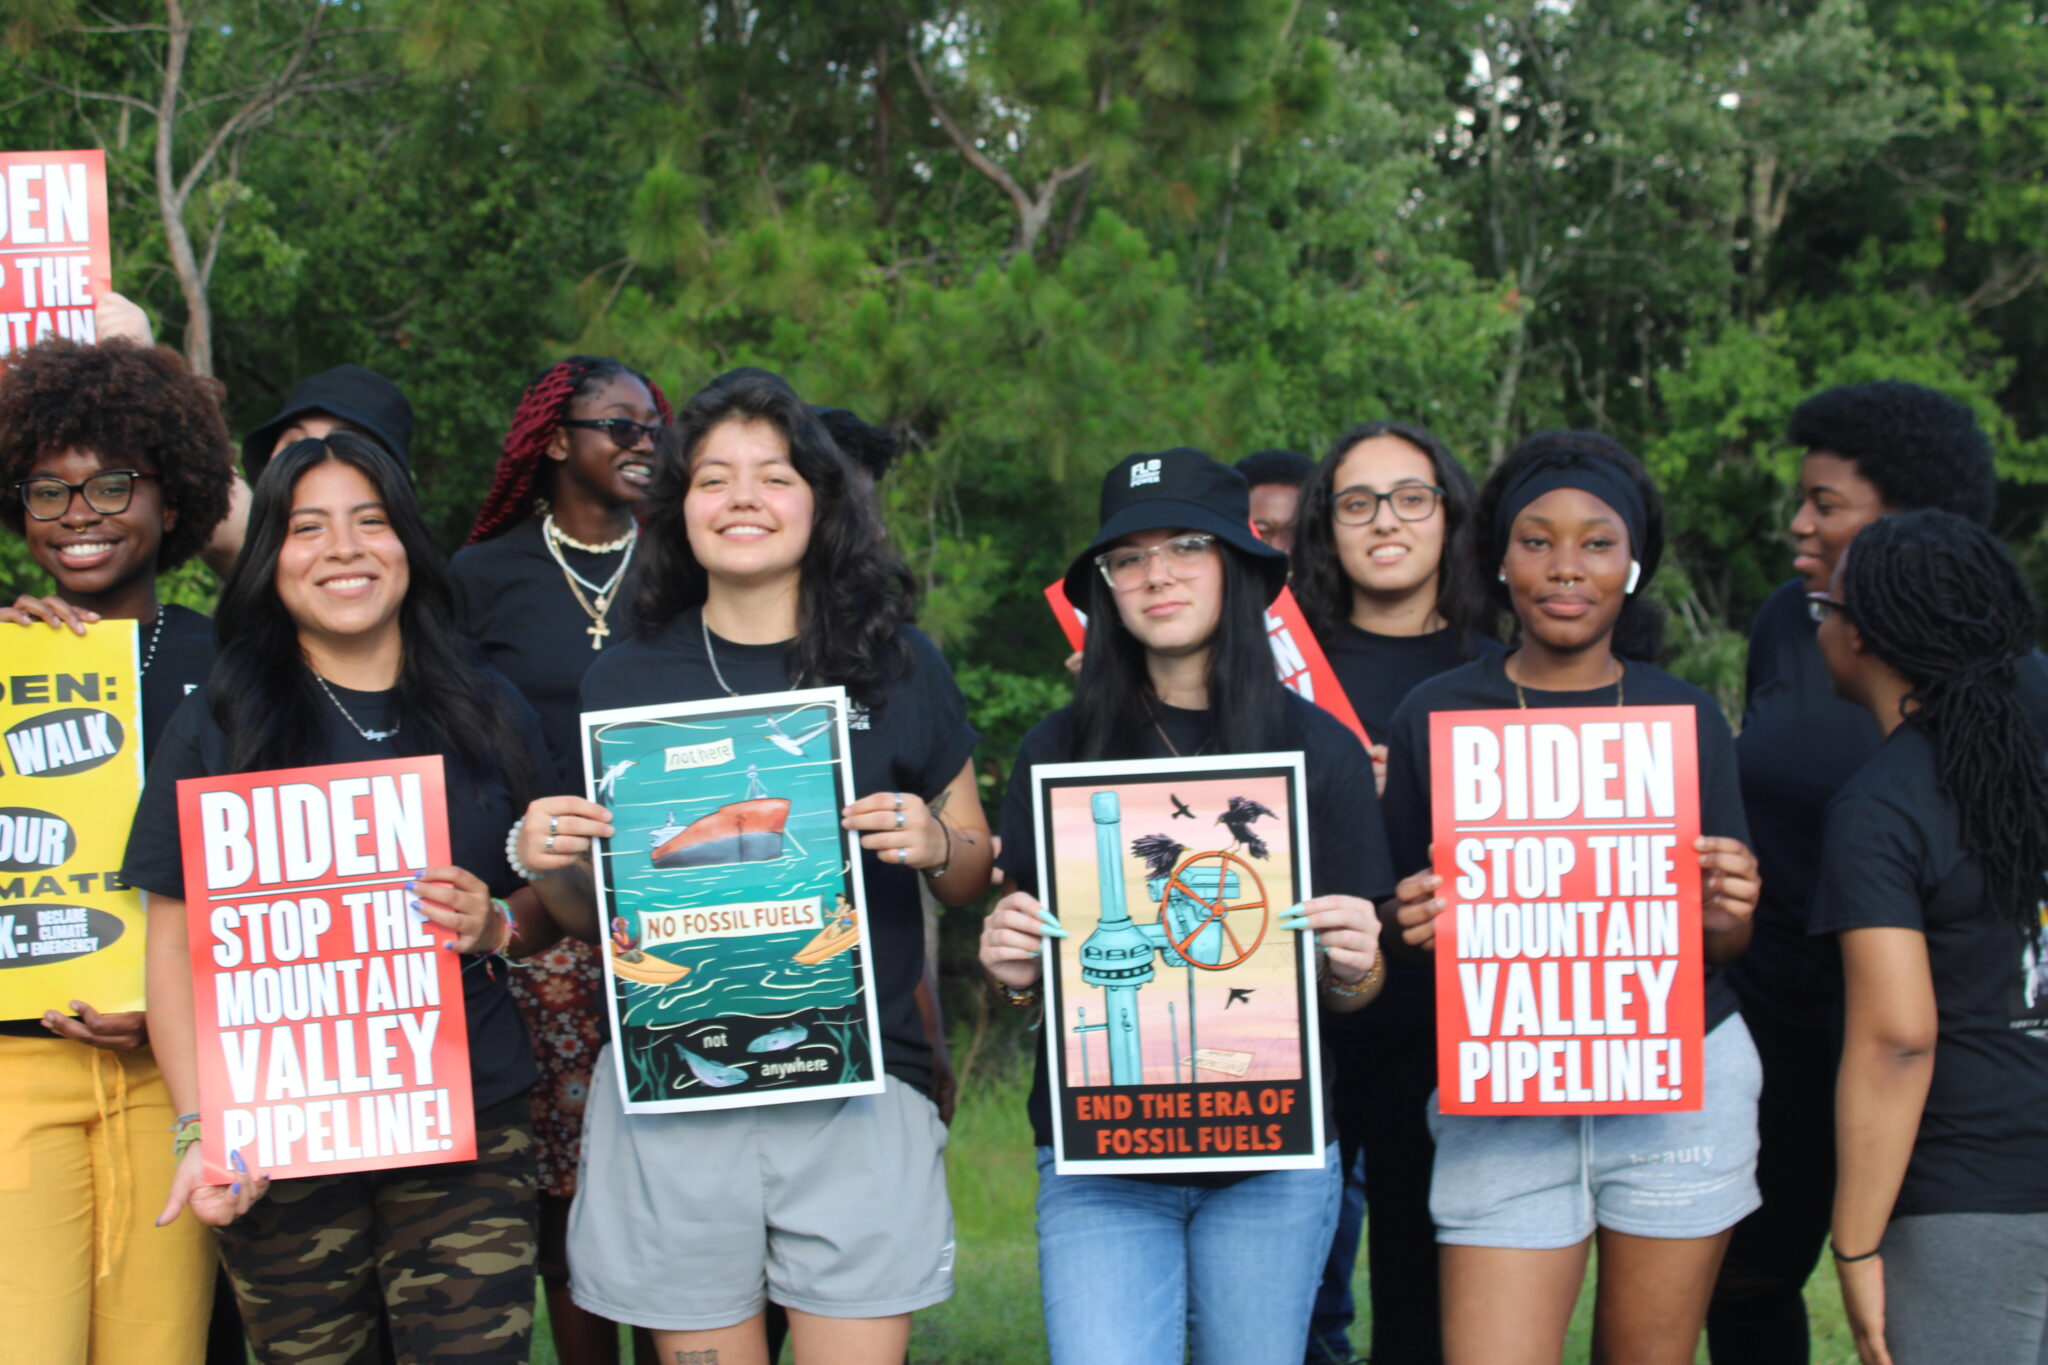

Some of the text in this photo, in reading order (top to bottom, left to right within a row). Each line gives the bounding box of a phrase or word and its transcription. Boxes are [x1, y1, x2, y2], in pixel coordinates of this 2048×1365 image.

[0, 163, 90, 244] EN
[15, 256, 93, 308] THE
[0, 672, 118, 706] EN:
[6, 712, 117, 776] WALK
[670, 745, 731, 766] not here
[1451, 721, 1676, 822] BIDEN
[200, 773, 428, 890] BIDEN
[1455, 835, 1677, 900] STOP THE
[30, 937, 99, 956] EMERGENCY
[36, 908, 88, 926] DECLARE
[39, 923, 89, 941] CLIMATE
[210, 888, 435, 968] STOP THE
[648, 905, 814, 940] NO FOSSIL FUELS
[1456, 900, 1679, 959] MOUNTAIN
[215, 951, 441, 1028] MOUNTAIN
[1458, 960, 1679, 1037] VALLEY
[219, 1010, 441, 1104] VALLEY
[702, 1033, 728, 1048] not
[761, 1057, 829, 1079] anywhere
[1459, 1038, 1683, 1103] PIPELINE!
[223, 1089, 453, 1171] PIPELINE!
[1076, 1088, 1295, 1121] END THE ERA OF
[1096, 1124, 1283, 1154] FOSSIL FUELS
